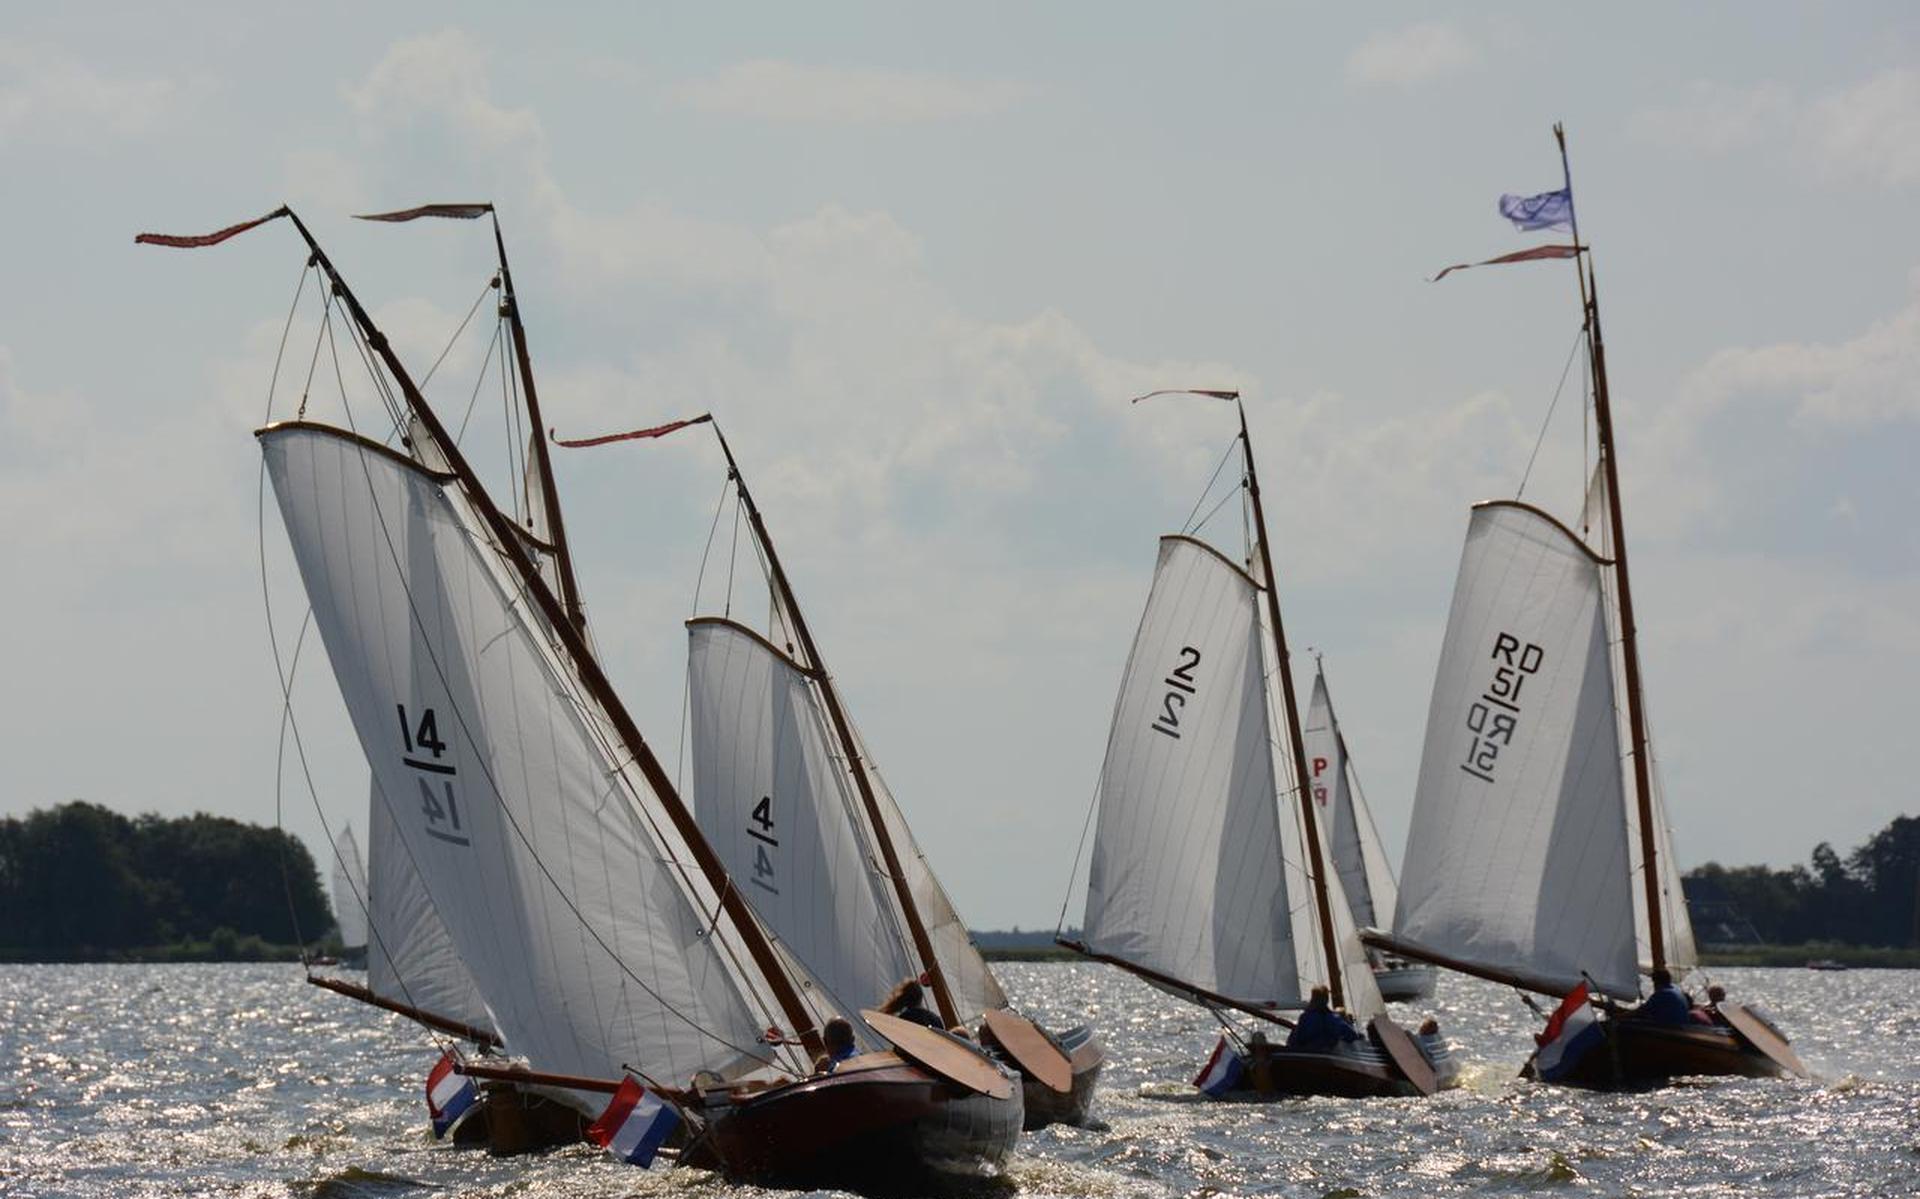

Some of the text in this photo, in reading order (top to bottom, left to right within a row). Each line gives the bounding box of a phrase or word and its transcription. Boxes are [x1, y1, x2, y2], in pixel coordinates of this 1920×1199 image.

[1173, 646, 1201, 682] 2
[1491, 632, 1544, 674] RD
[397, 704, 446, 758] 14
[1312, 758, 1327, 777] P
[752, 796, 774, 831] 4
